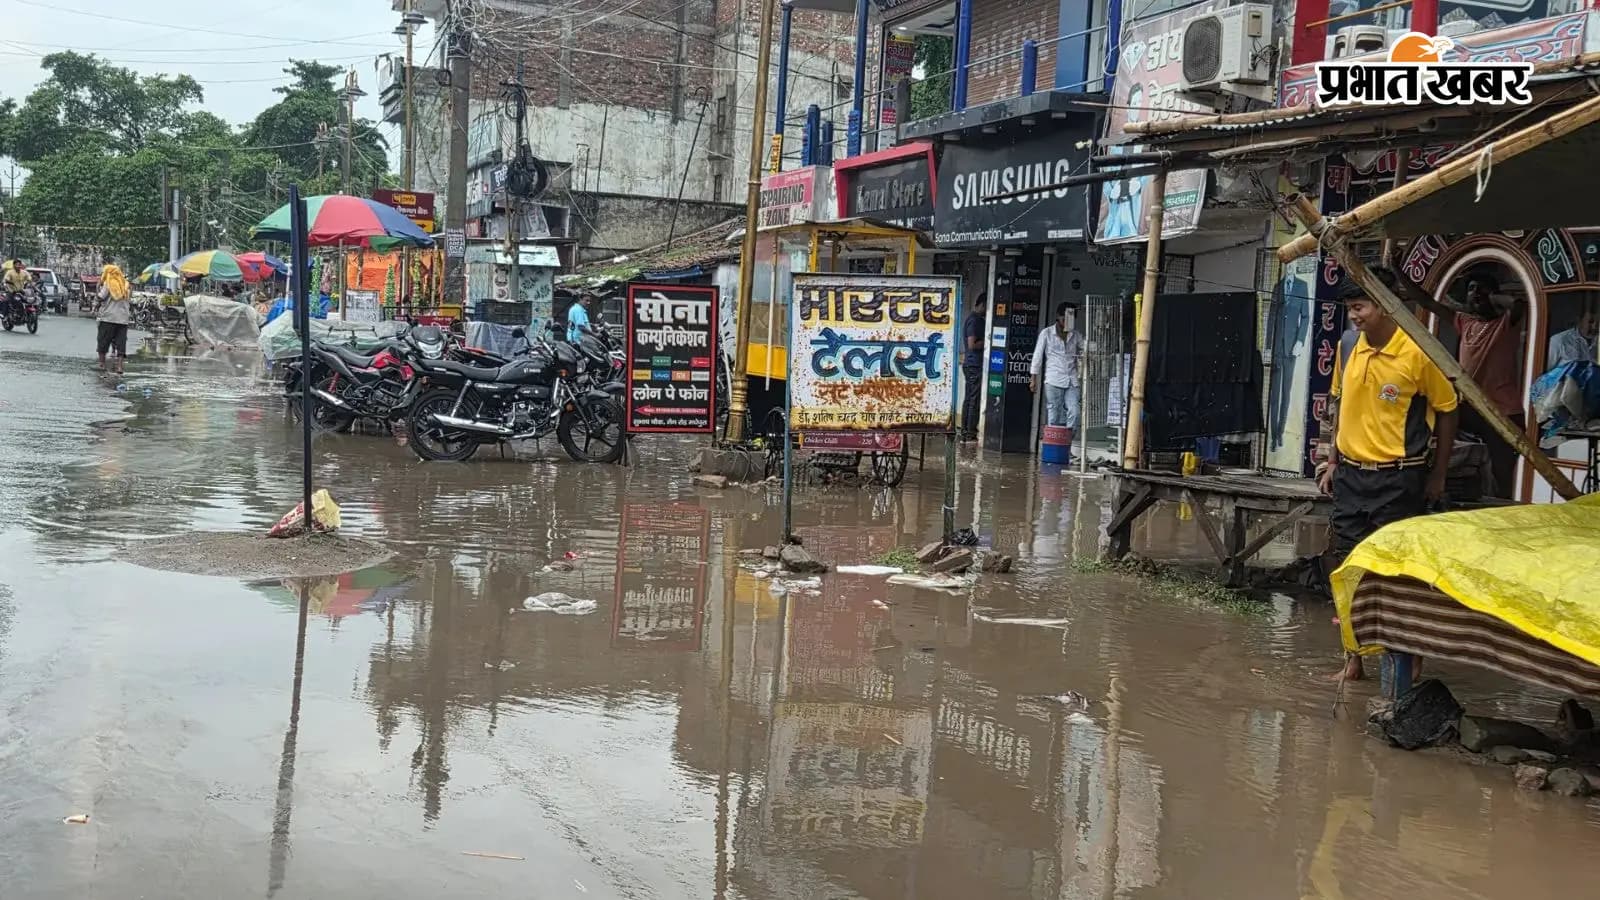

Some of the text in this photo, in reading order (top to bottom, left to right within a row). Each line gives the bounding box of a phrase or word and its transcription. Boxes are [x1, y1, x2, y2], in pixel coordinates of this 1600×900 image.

[761, 183, 805, 208] EPAIRING
[892, 178, 924, 210] Store
[952, 158, 1070, 210] SAMSUNG
[766, 207, 790, 226] ZONE
[951, 227, 1003, 242] Communication
[634, 292, 711, 325] सोना
[795, 284, 953, 325] मास्टर
[636, 325, 708, 351] कम्युनिकेशन
[632, 383, 709, 401] लोन पे फोन
